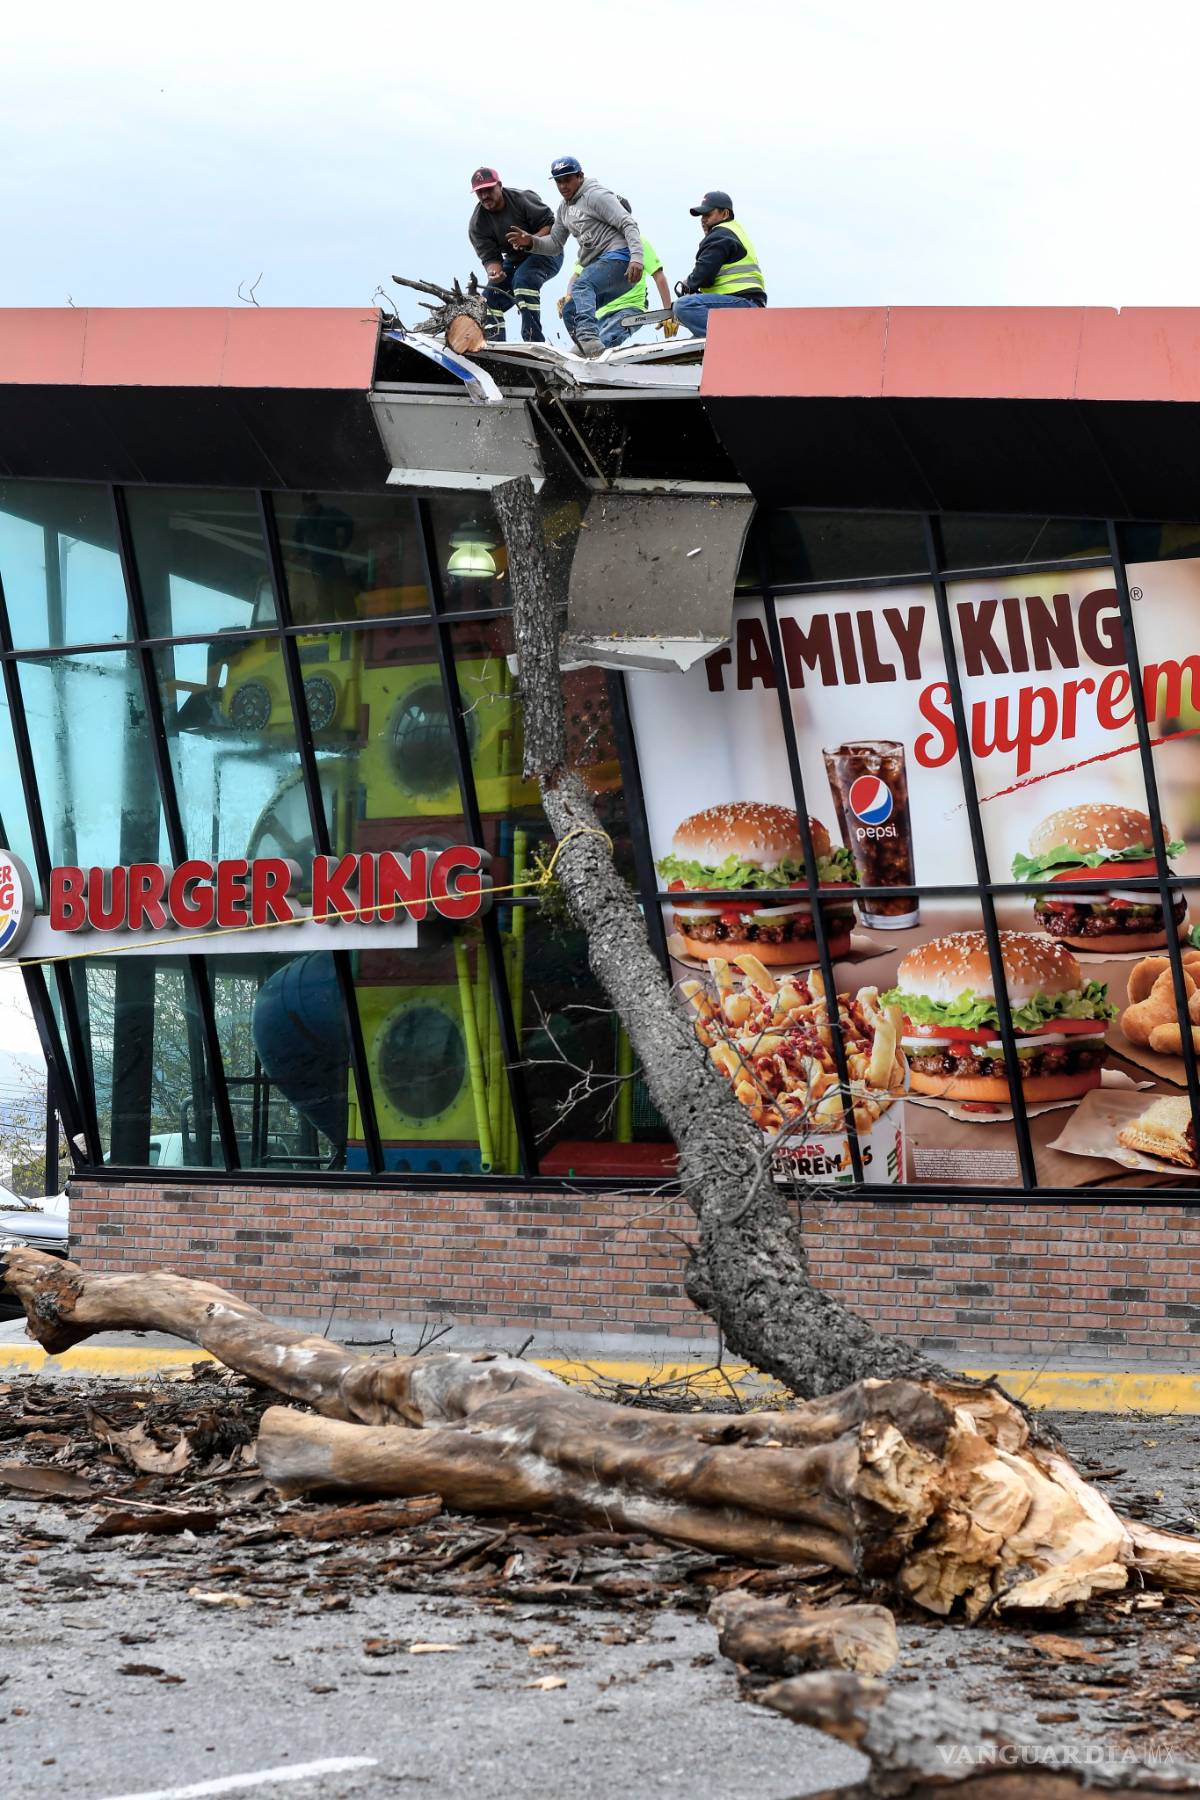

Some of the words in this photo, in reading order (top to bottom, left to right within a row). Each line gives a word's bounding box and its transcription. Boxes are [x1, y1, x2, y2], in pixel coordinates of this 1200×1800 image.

[957, 589, 1129, 677] KING
[856, 823, 897, 842] pepsi
[50, 858, 294, 932] BURGER
[312, 845, 484, 925] KING
